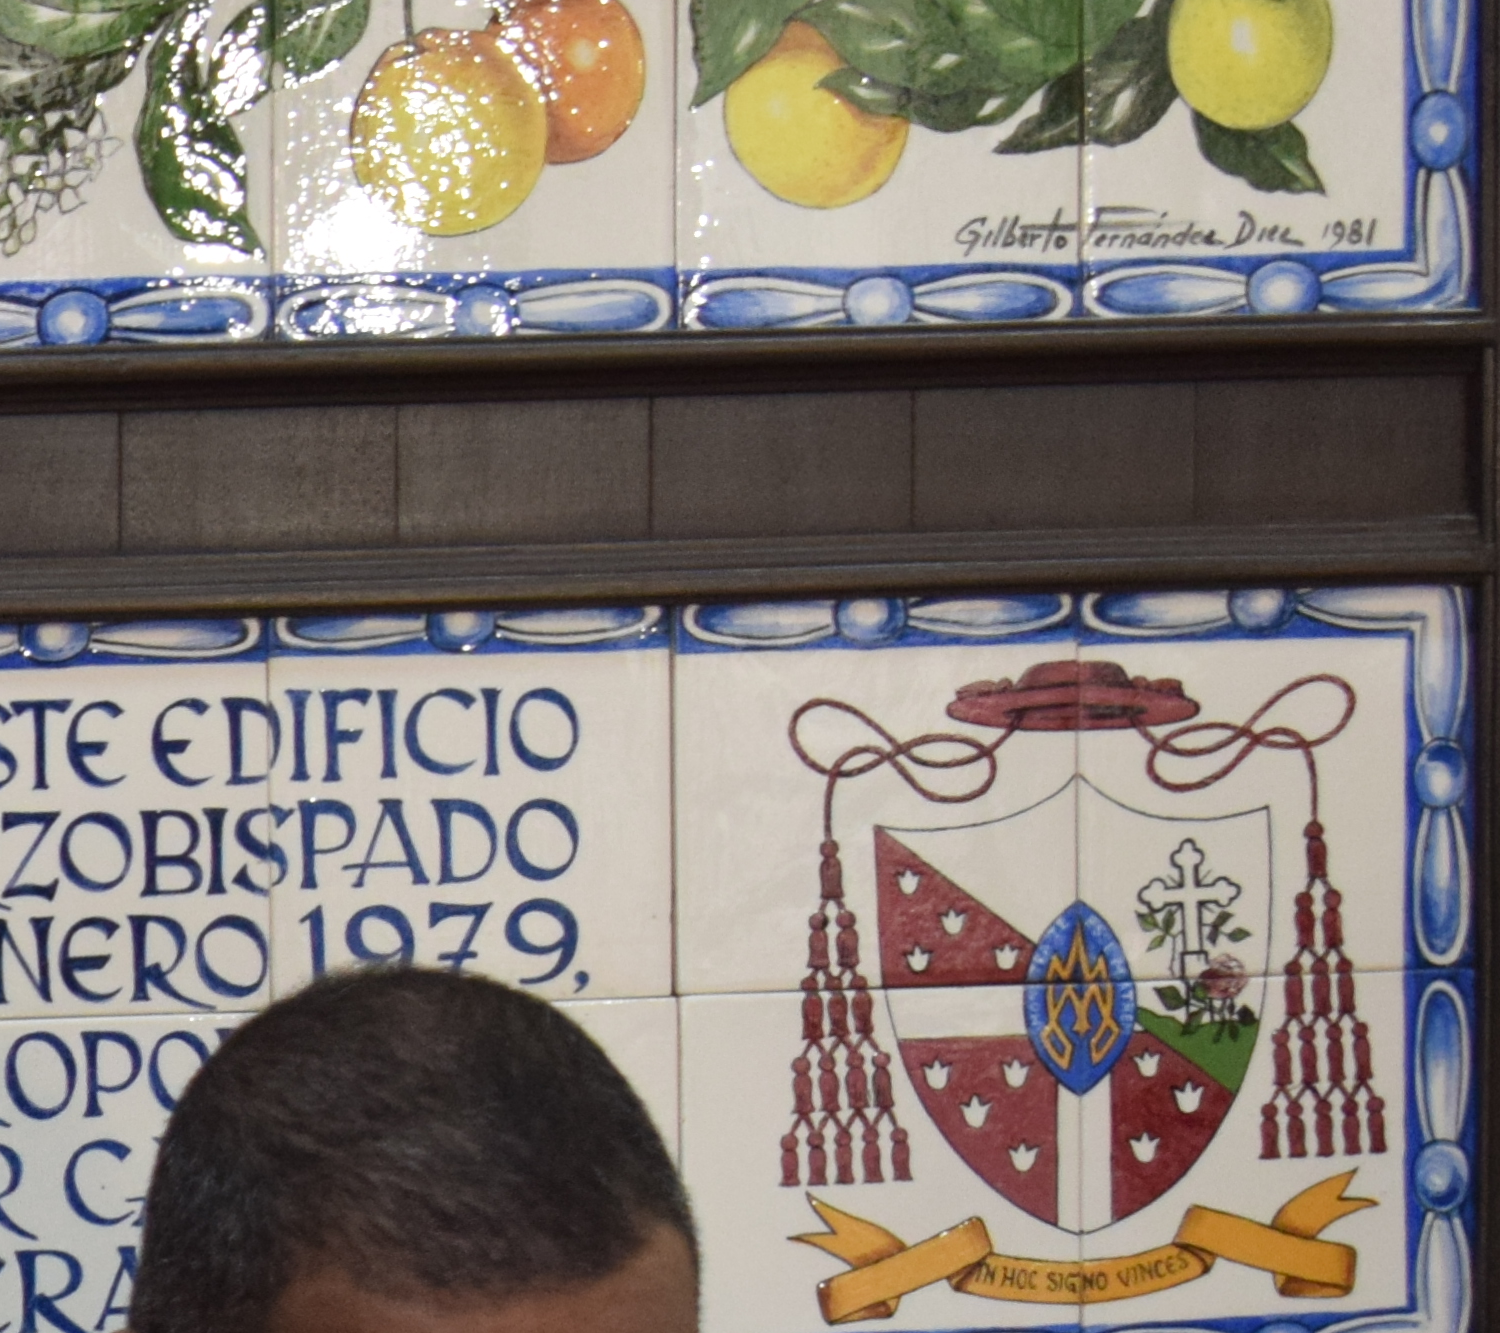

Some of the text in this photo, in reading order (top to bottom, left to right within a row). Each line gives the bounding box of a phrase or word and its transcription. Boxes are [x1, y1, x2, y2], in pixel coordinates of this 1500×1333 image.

[955, 207, 1070, 257] Gilberto
[1321, 217, 1378, 247] 1981
[151, 687, 580, 788] EDIFICIO
[974, 1253, 1191, 1294] IN HOC SIGNO VINCES
